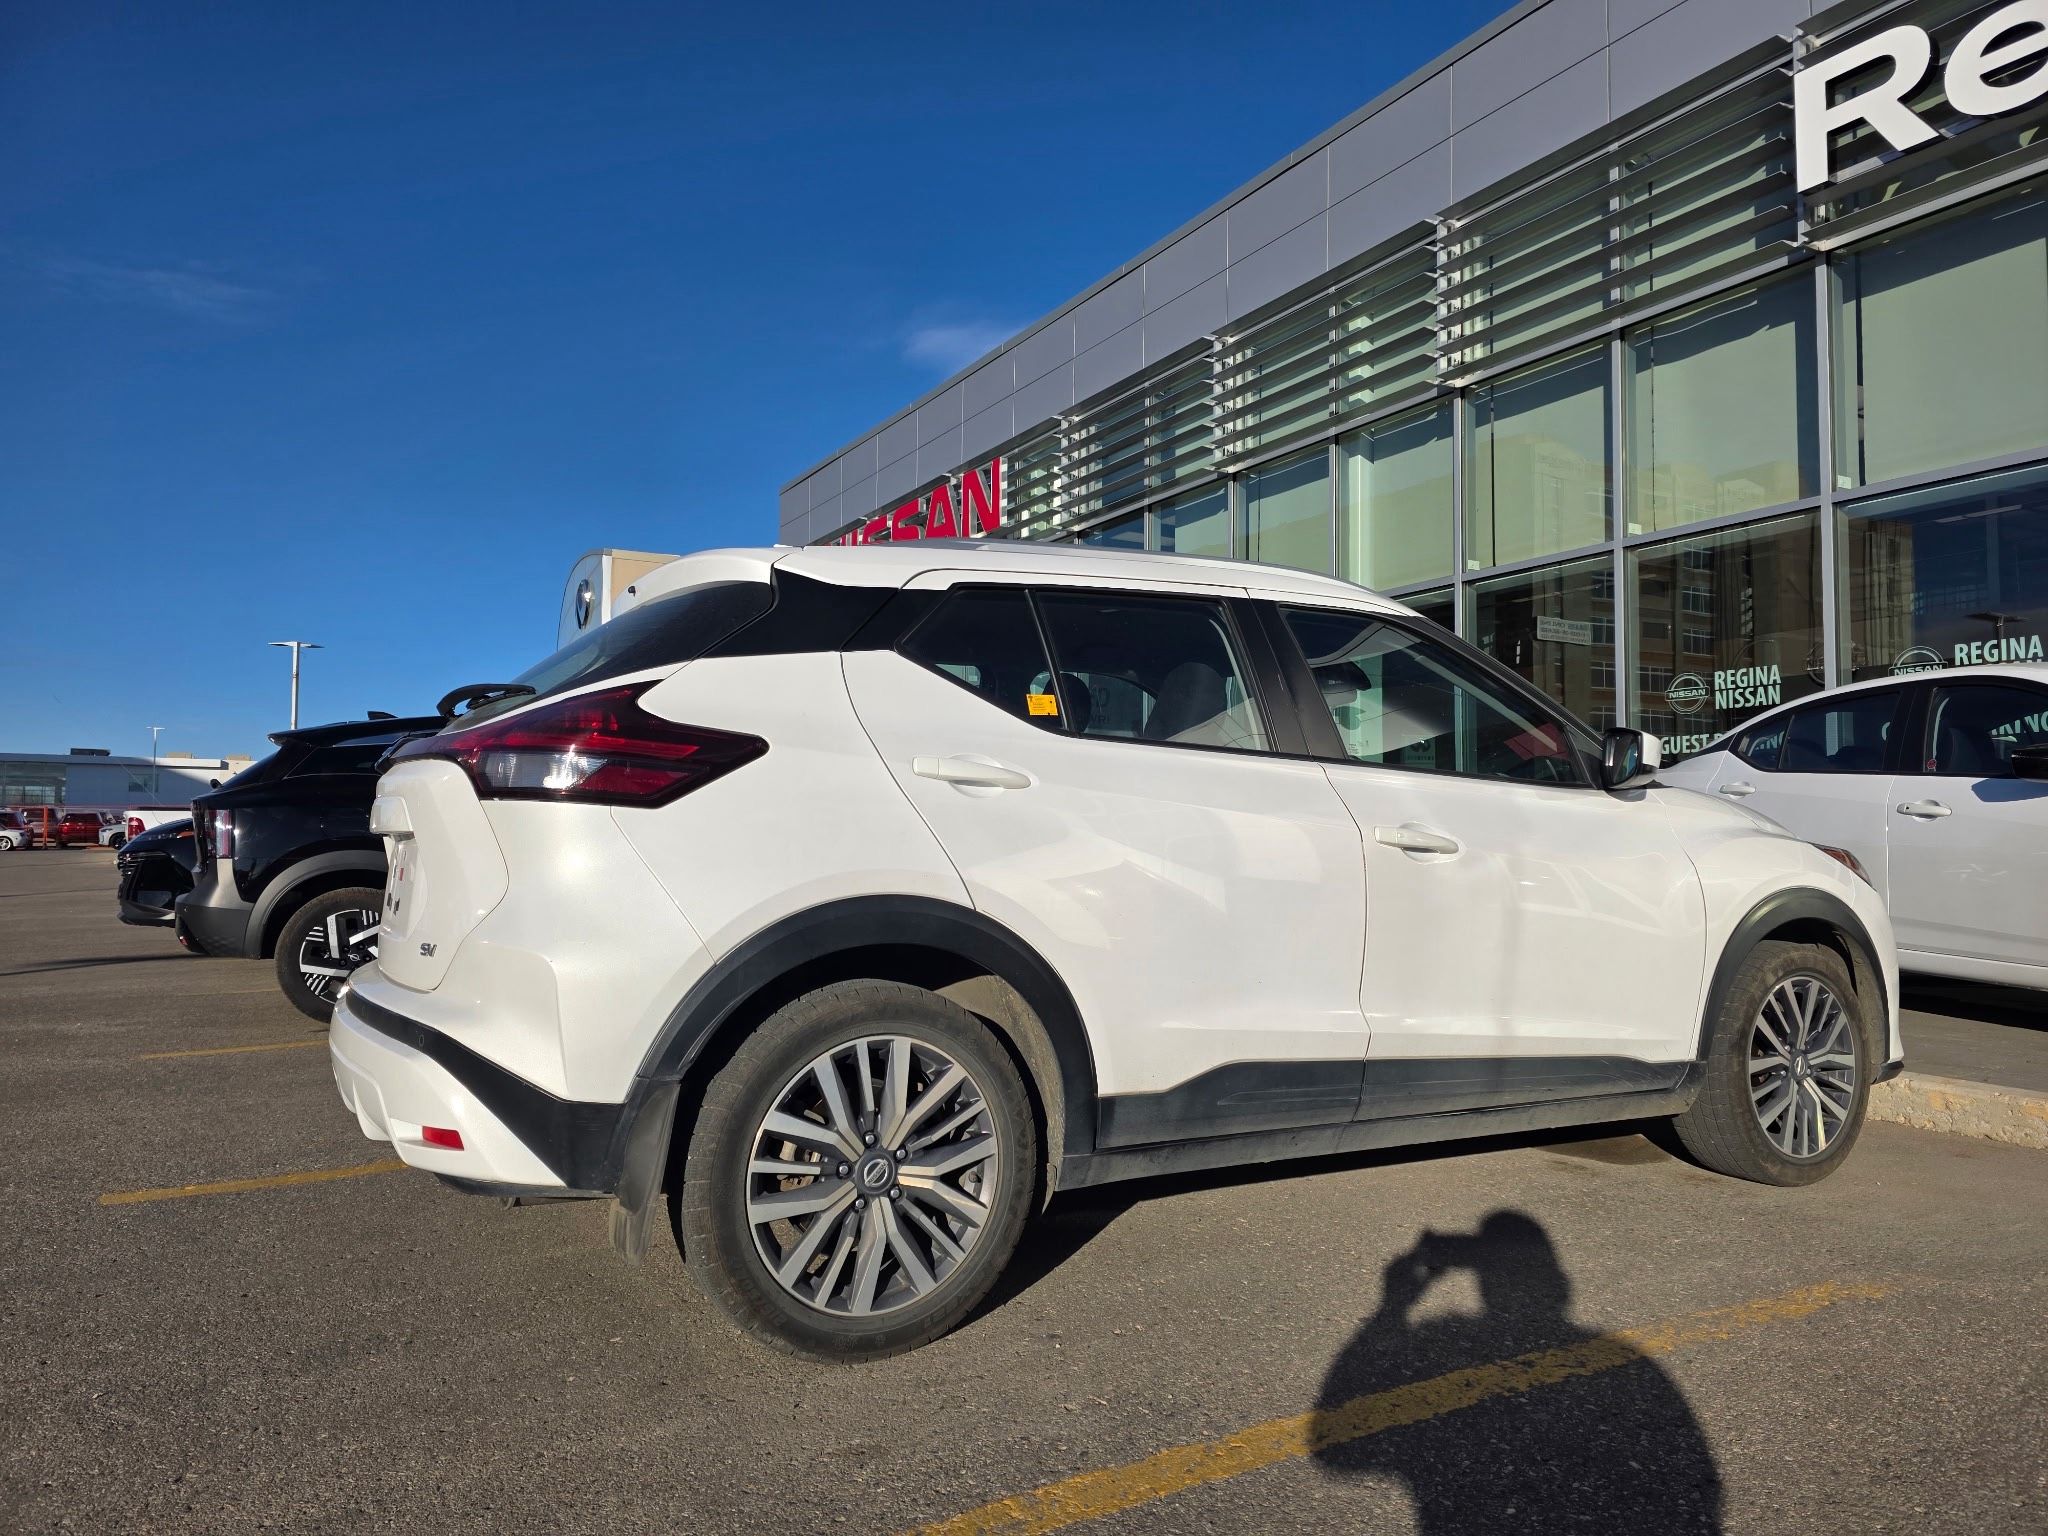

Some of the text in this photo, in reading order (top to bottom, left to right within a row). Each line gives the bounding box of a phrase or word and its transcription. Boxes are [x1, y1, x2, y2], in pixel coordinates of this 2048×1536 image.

[1794, 0, 2048, 193] Re
[822, 456, 1001, 546] SAN
[1954, 634, 2044, 666] REGINA
[1714, 664, 1782, 690] REGINA
[1669, 688, 1706, 699] NISSAN
[1715, 684, 1781, 710] NISSAN
[1660, 733, 1710, 755] GUEST
[420, 942, 438, 957] SV
